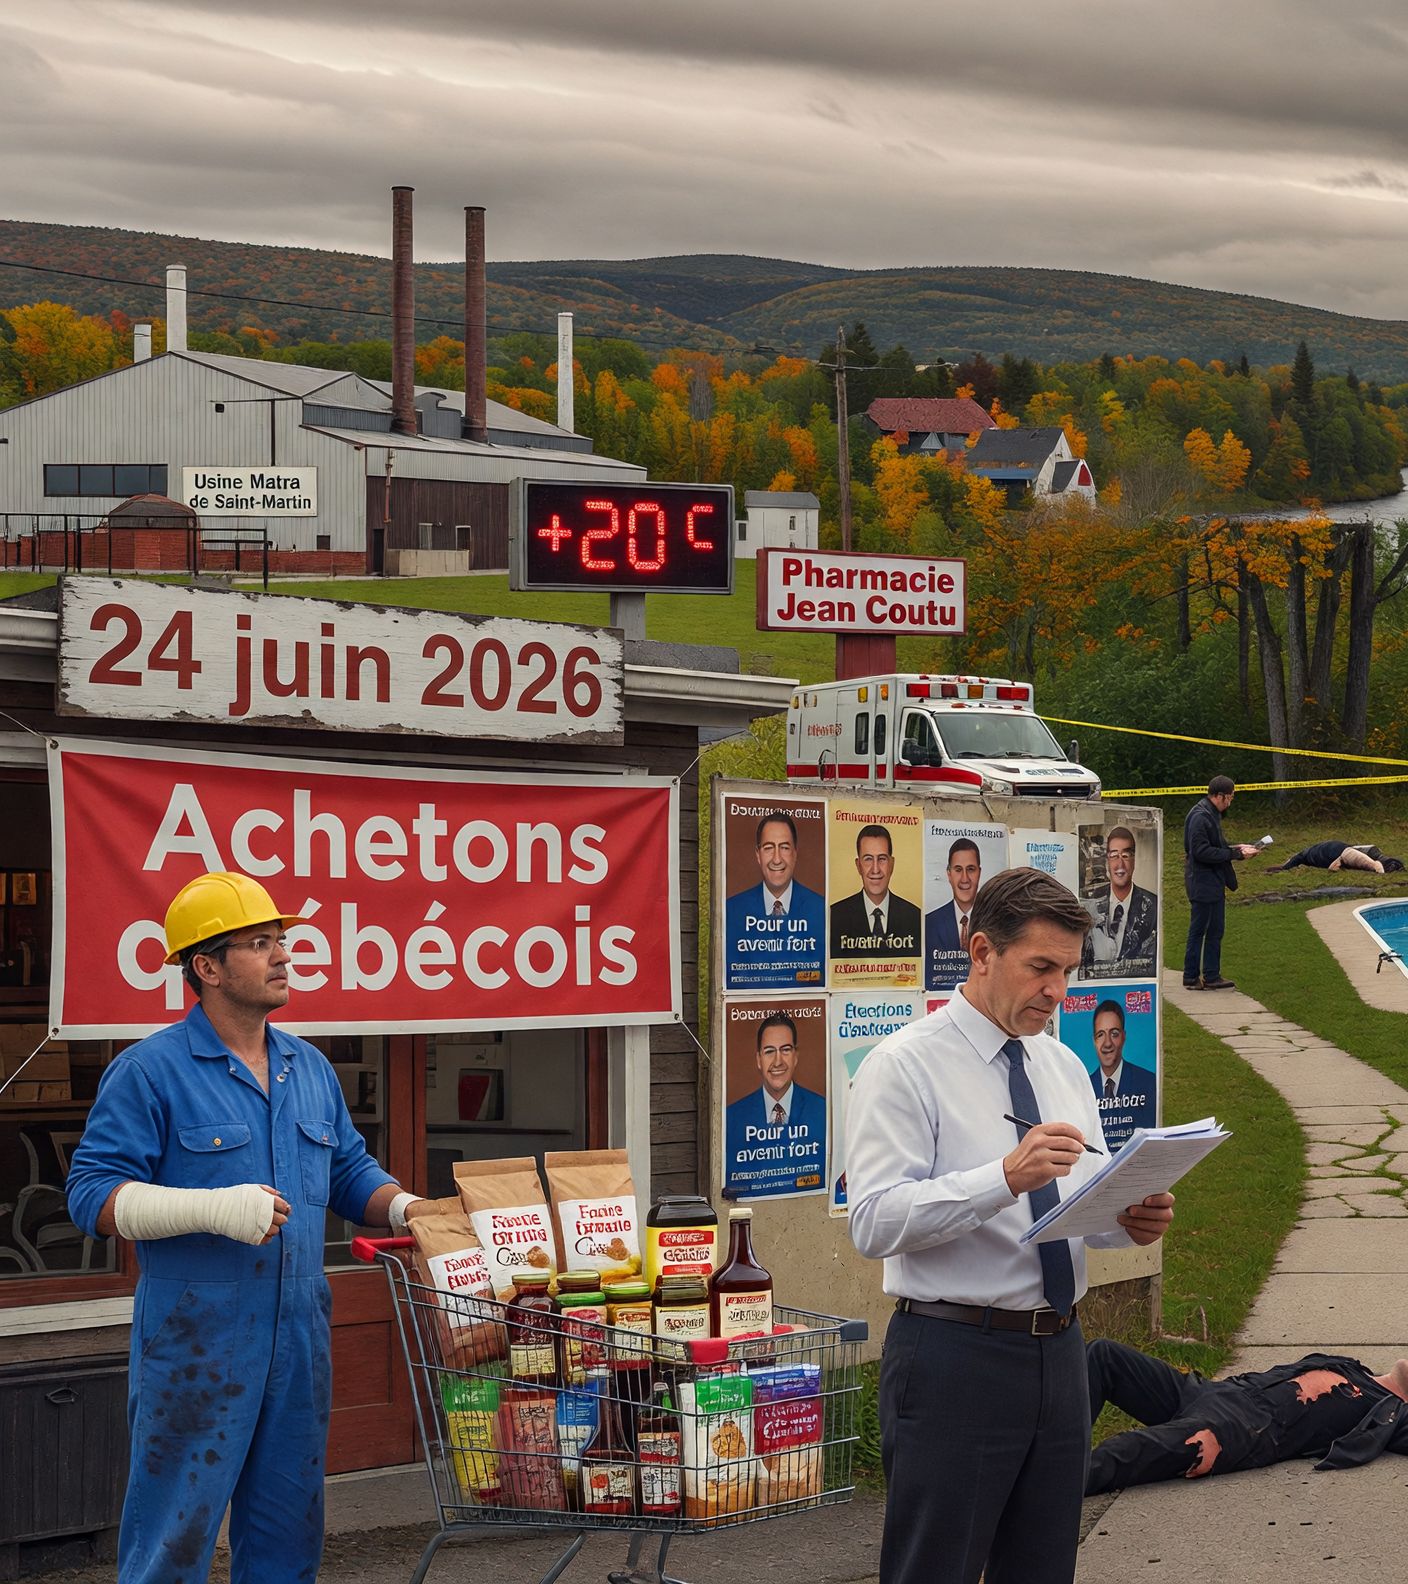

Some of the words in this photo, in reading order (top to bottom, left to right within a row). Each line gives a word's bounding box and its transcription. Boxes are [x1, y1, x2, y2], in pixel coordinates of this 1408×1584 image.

[194, 474, 243, 490] Usine
[250, 474, 300, 490] Matra
[190, 494, 208, 509] de
[215, 494, 312, 510] Saint-Martin
[538, 500, 667, 571] +20
[686, 504, 715, 550] C
[783, 558, 955, 594] Pharmacie
[777, 593, 857, 623] Jean
[865, 595, 957, 627] Coutu
[89, 603, 202, 690] 24
[229, 614, 392, 717] juin
[420, 633, 604, 719] 2026
[142, 783, 609, 886] Achetons
[745, 916, 784, 932] Pour
[787, 919, 808, 932] un
[117, 897, 639, 1010] qébécois
[745, 1125, 785, 1142] Pour
[788, 1125, 809, 1139] un
